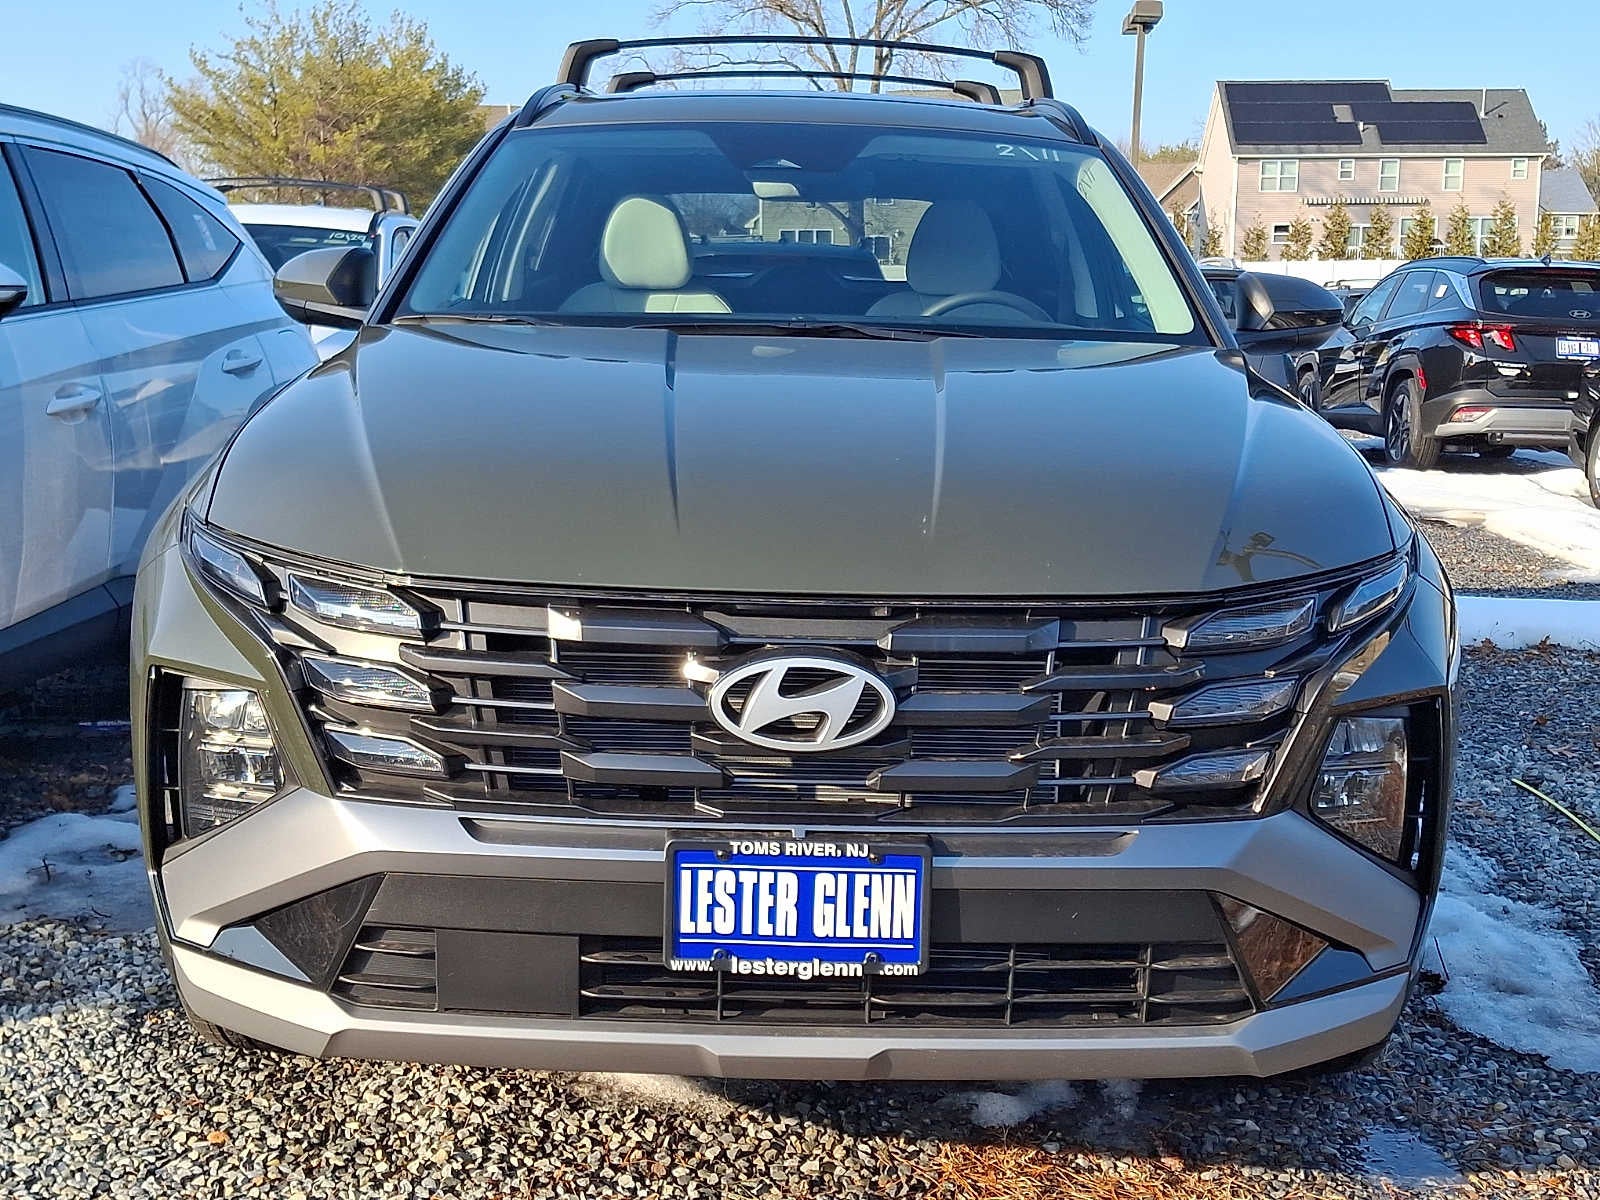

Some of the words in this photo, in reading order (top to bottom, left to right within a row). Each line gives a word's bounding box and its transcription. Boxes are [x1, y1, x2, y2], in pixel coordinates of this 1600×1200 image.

[729, 841, 780, 856] TOMS
[785, 842, 842, 858] RIVER,
[846, 843, 869, 858] NJ
[680, 869, 799, 937] LESTER
[813, 872, 916, 939] GLENN
[731, 955, 863, 980] lesterglenn
